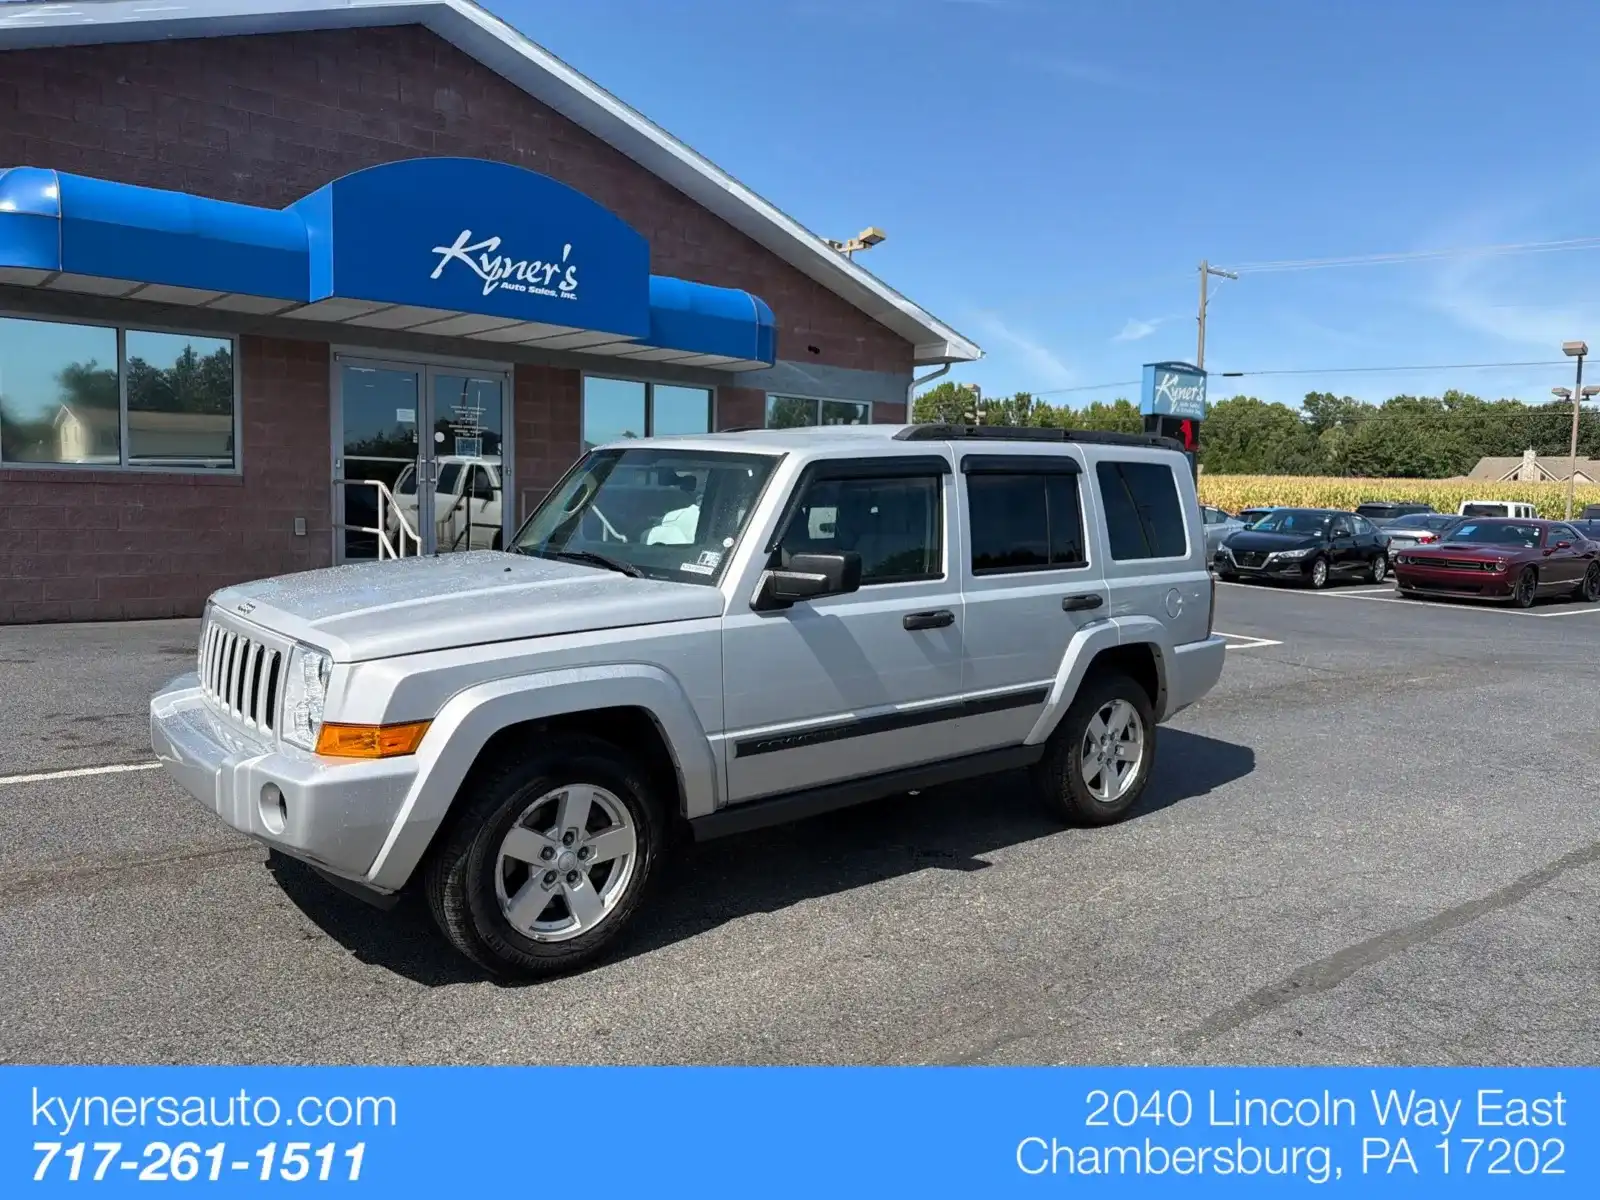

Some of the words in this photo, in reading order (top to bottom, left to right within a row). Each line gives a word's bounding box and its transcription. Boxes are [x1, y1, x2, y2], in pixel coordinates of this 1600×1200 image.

[430, 229, 578, 296] Kyner's
[500, 281, 527, 293] Auto
[528, 286, 558, 298] Sales,
[560, 291, 578, 301] Inc.
[1154, 372, 1205, 414] Kyner's
